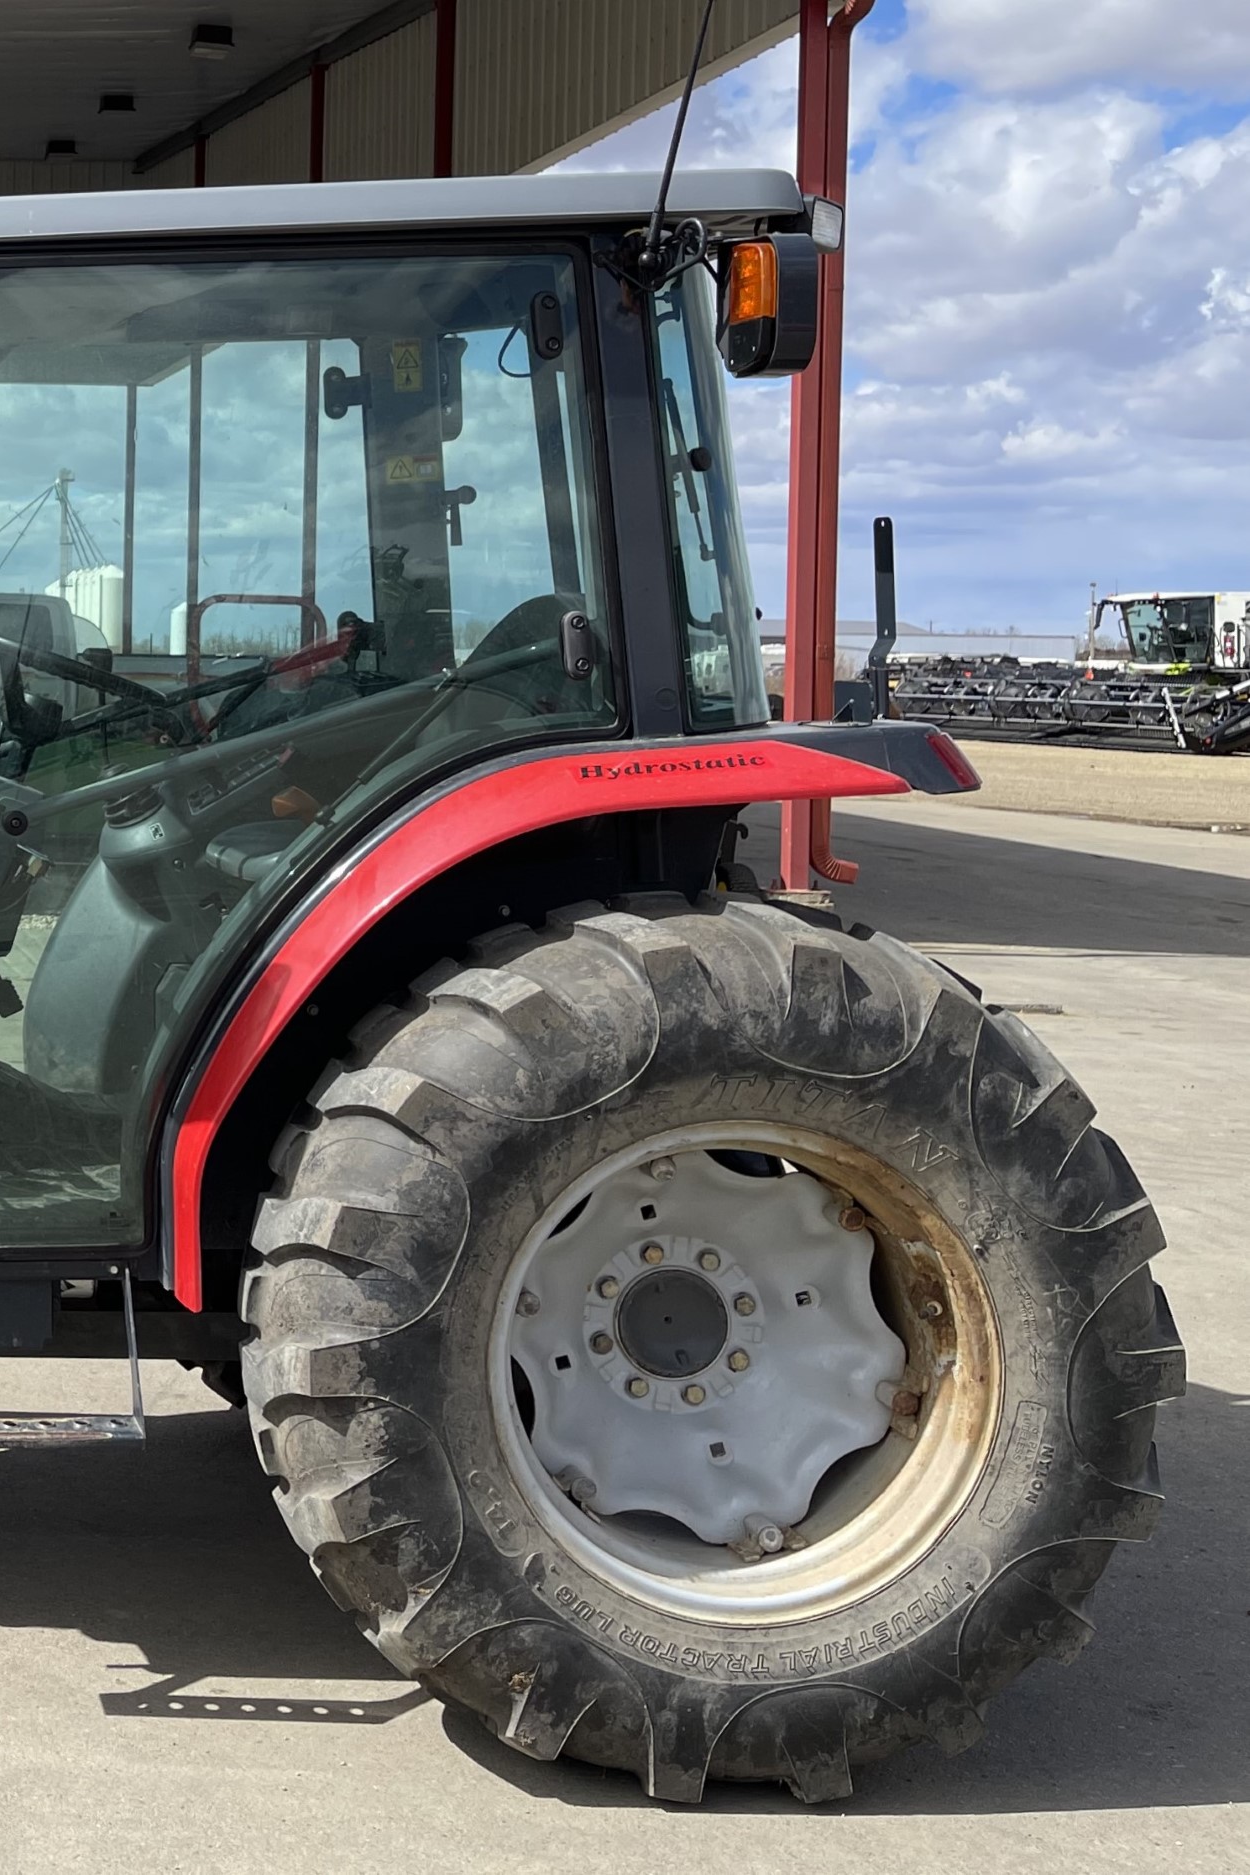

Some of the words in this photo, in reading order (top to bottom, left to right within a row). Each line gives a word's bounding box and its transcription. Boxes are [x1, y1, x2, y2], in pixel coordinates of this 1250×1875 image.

[580, 754, 766, 780] Hydrostatic
[710, 1073, 960, 1173] TITAN
[1023, 1444, 1055, 1504] NYLON
[555, 1585, 614, 1632] LUG
[779, 1576, 956, 1675] INDUSTRIAL
[618, 1623, 770, 1674] TRACTOR
